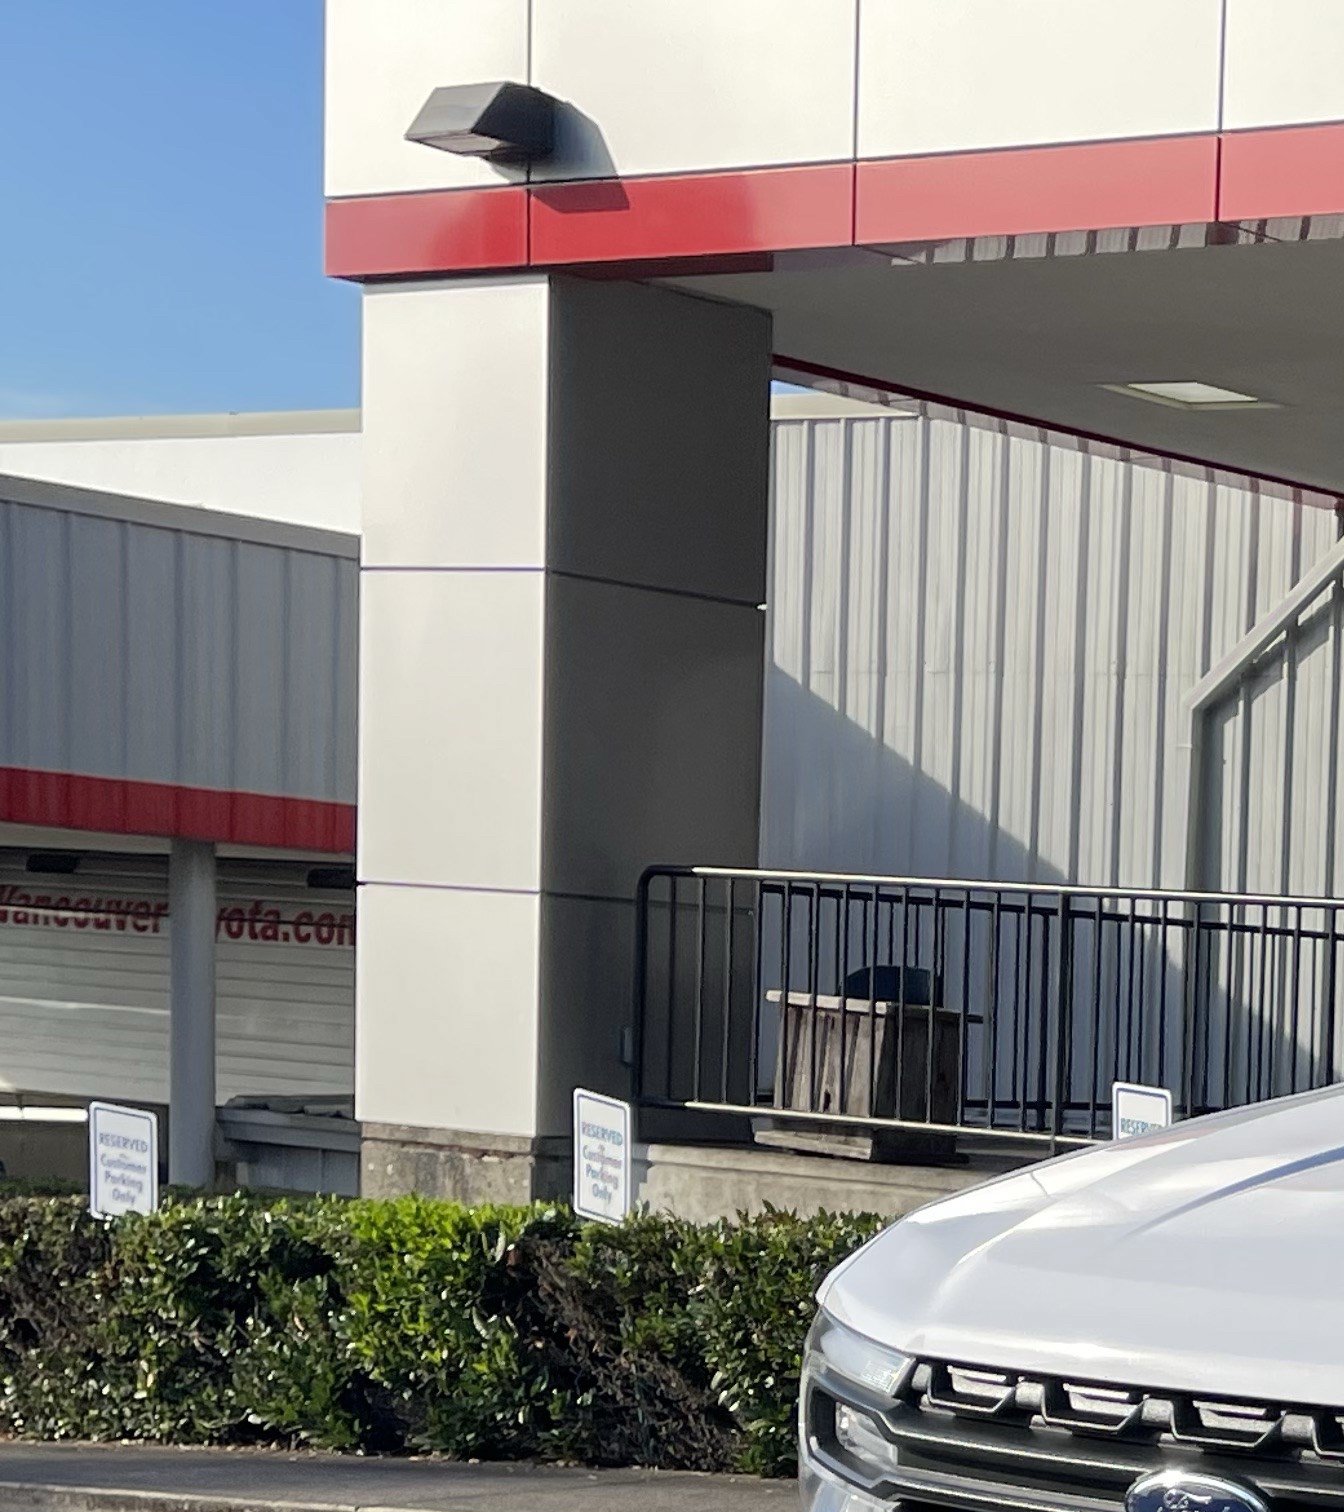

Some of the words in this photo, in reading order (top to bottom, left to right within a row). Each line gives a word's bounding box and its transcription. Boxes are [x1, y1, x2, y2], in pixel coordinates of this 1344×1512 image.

[99, 1132, 148, 1152] RESERVED
[582, 1120, 623, 1146] RESERVED
[101, 1153, 147, 1173] Customer
[582, 1145, 622, 1169] Customer
[105, 1170, 143, 1194] Parking
[586, 1163, 618, 1190] Parking
[112, 1188, 135, 1206] Only
[592, 1183, 612, 1204] Only
